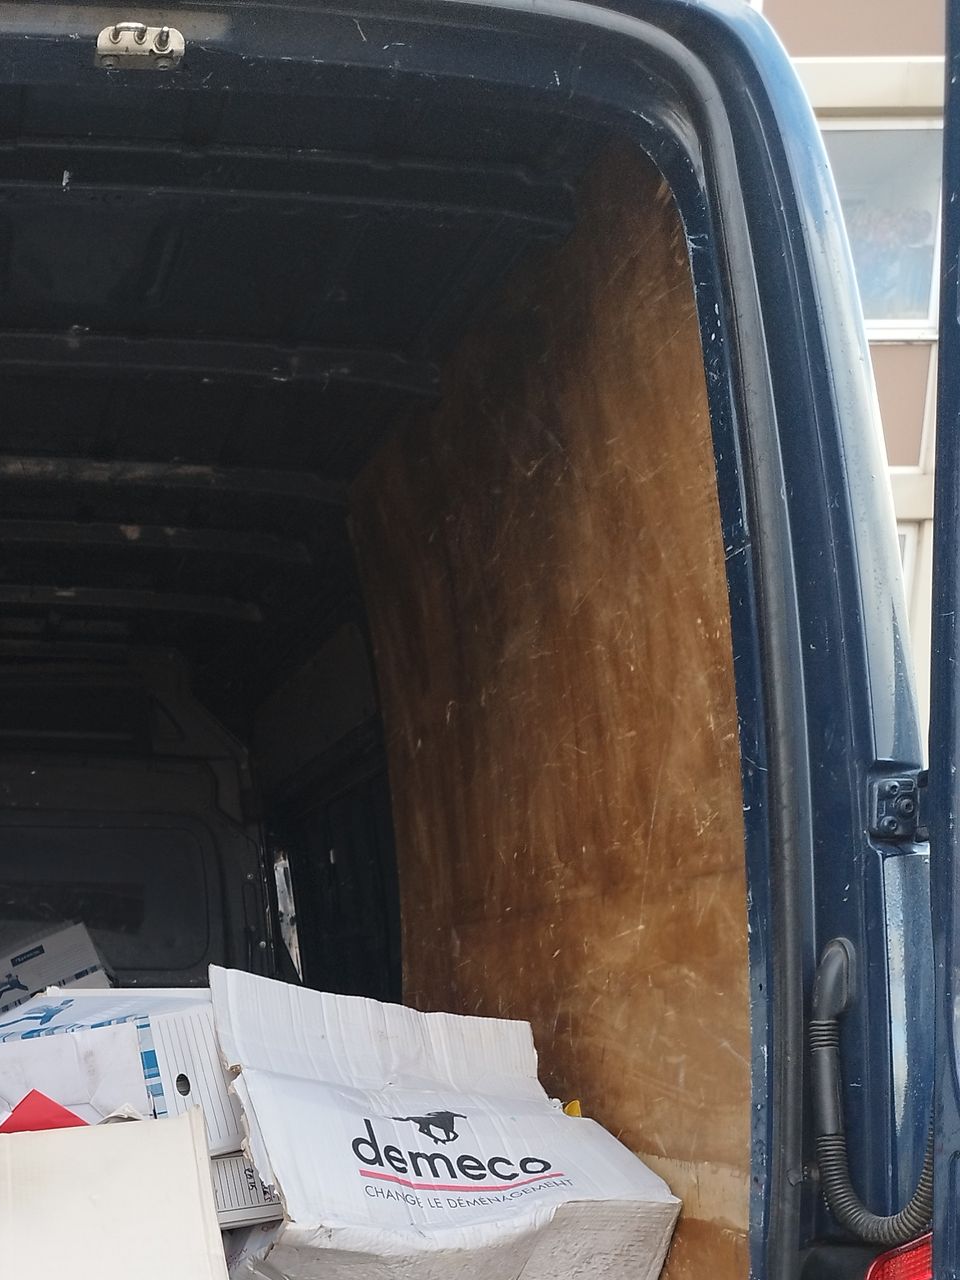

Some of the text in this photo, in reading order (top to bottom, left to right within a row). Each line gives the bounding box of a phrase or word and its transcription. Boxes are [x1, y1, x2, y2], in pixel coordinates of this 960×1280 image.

[352, 1119, 552, 1181] demeco
[365, 1177, 574, 1209] CHANGE LE DÉMÉNAGEMENT
